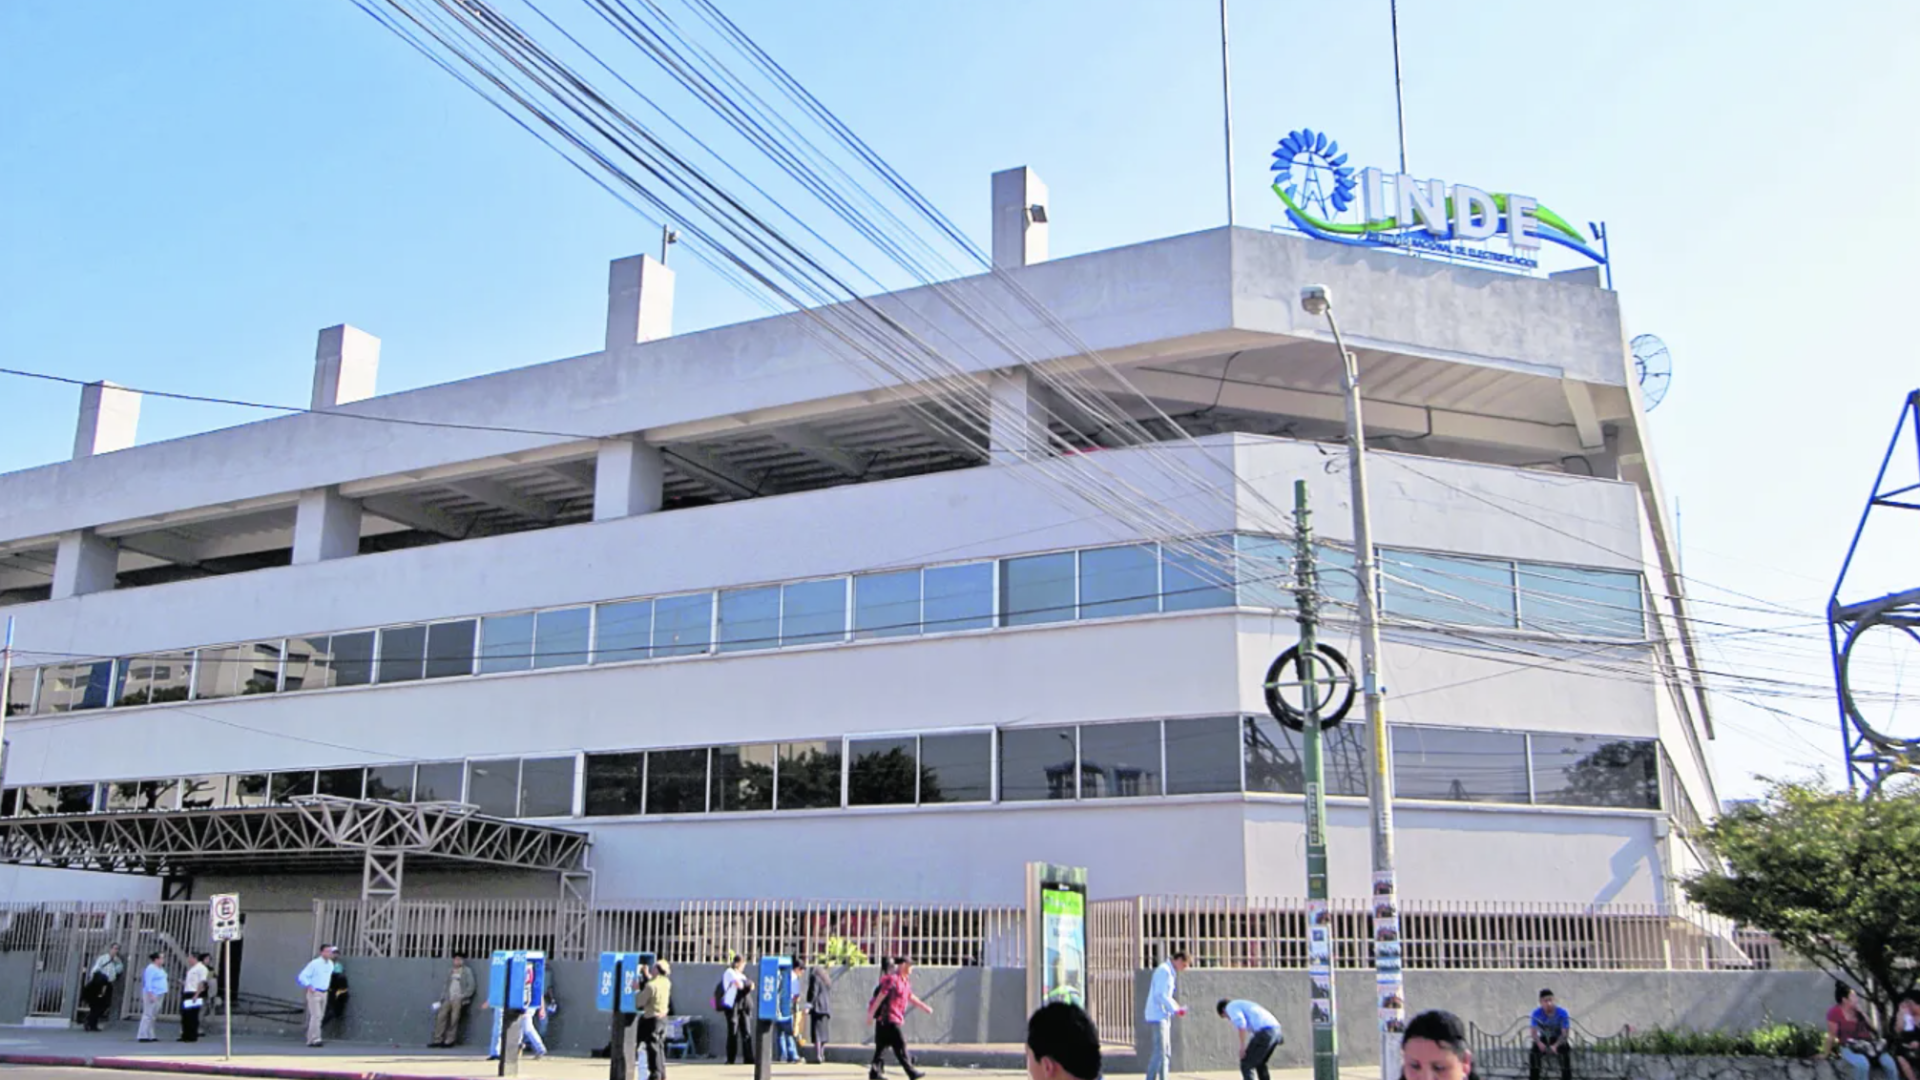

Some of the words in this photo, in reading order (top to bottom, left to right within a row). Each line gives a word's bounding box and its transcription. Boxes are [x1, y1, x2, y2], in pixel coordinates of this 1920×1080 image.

[1363, 167, 1540, 249] INDE
[1412, 238, 1452, 254] NACIONAL
[1456, 246, 1467, 256] DE
